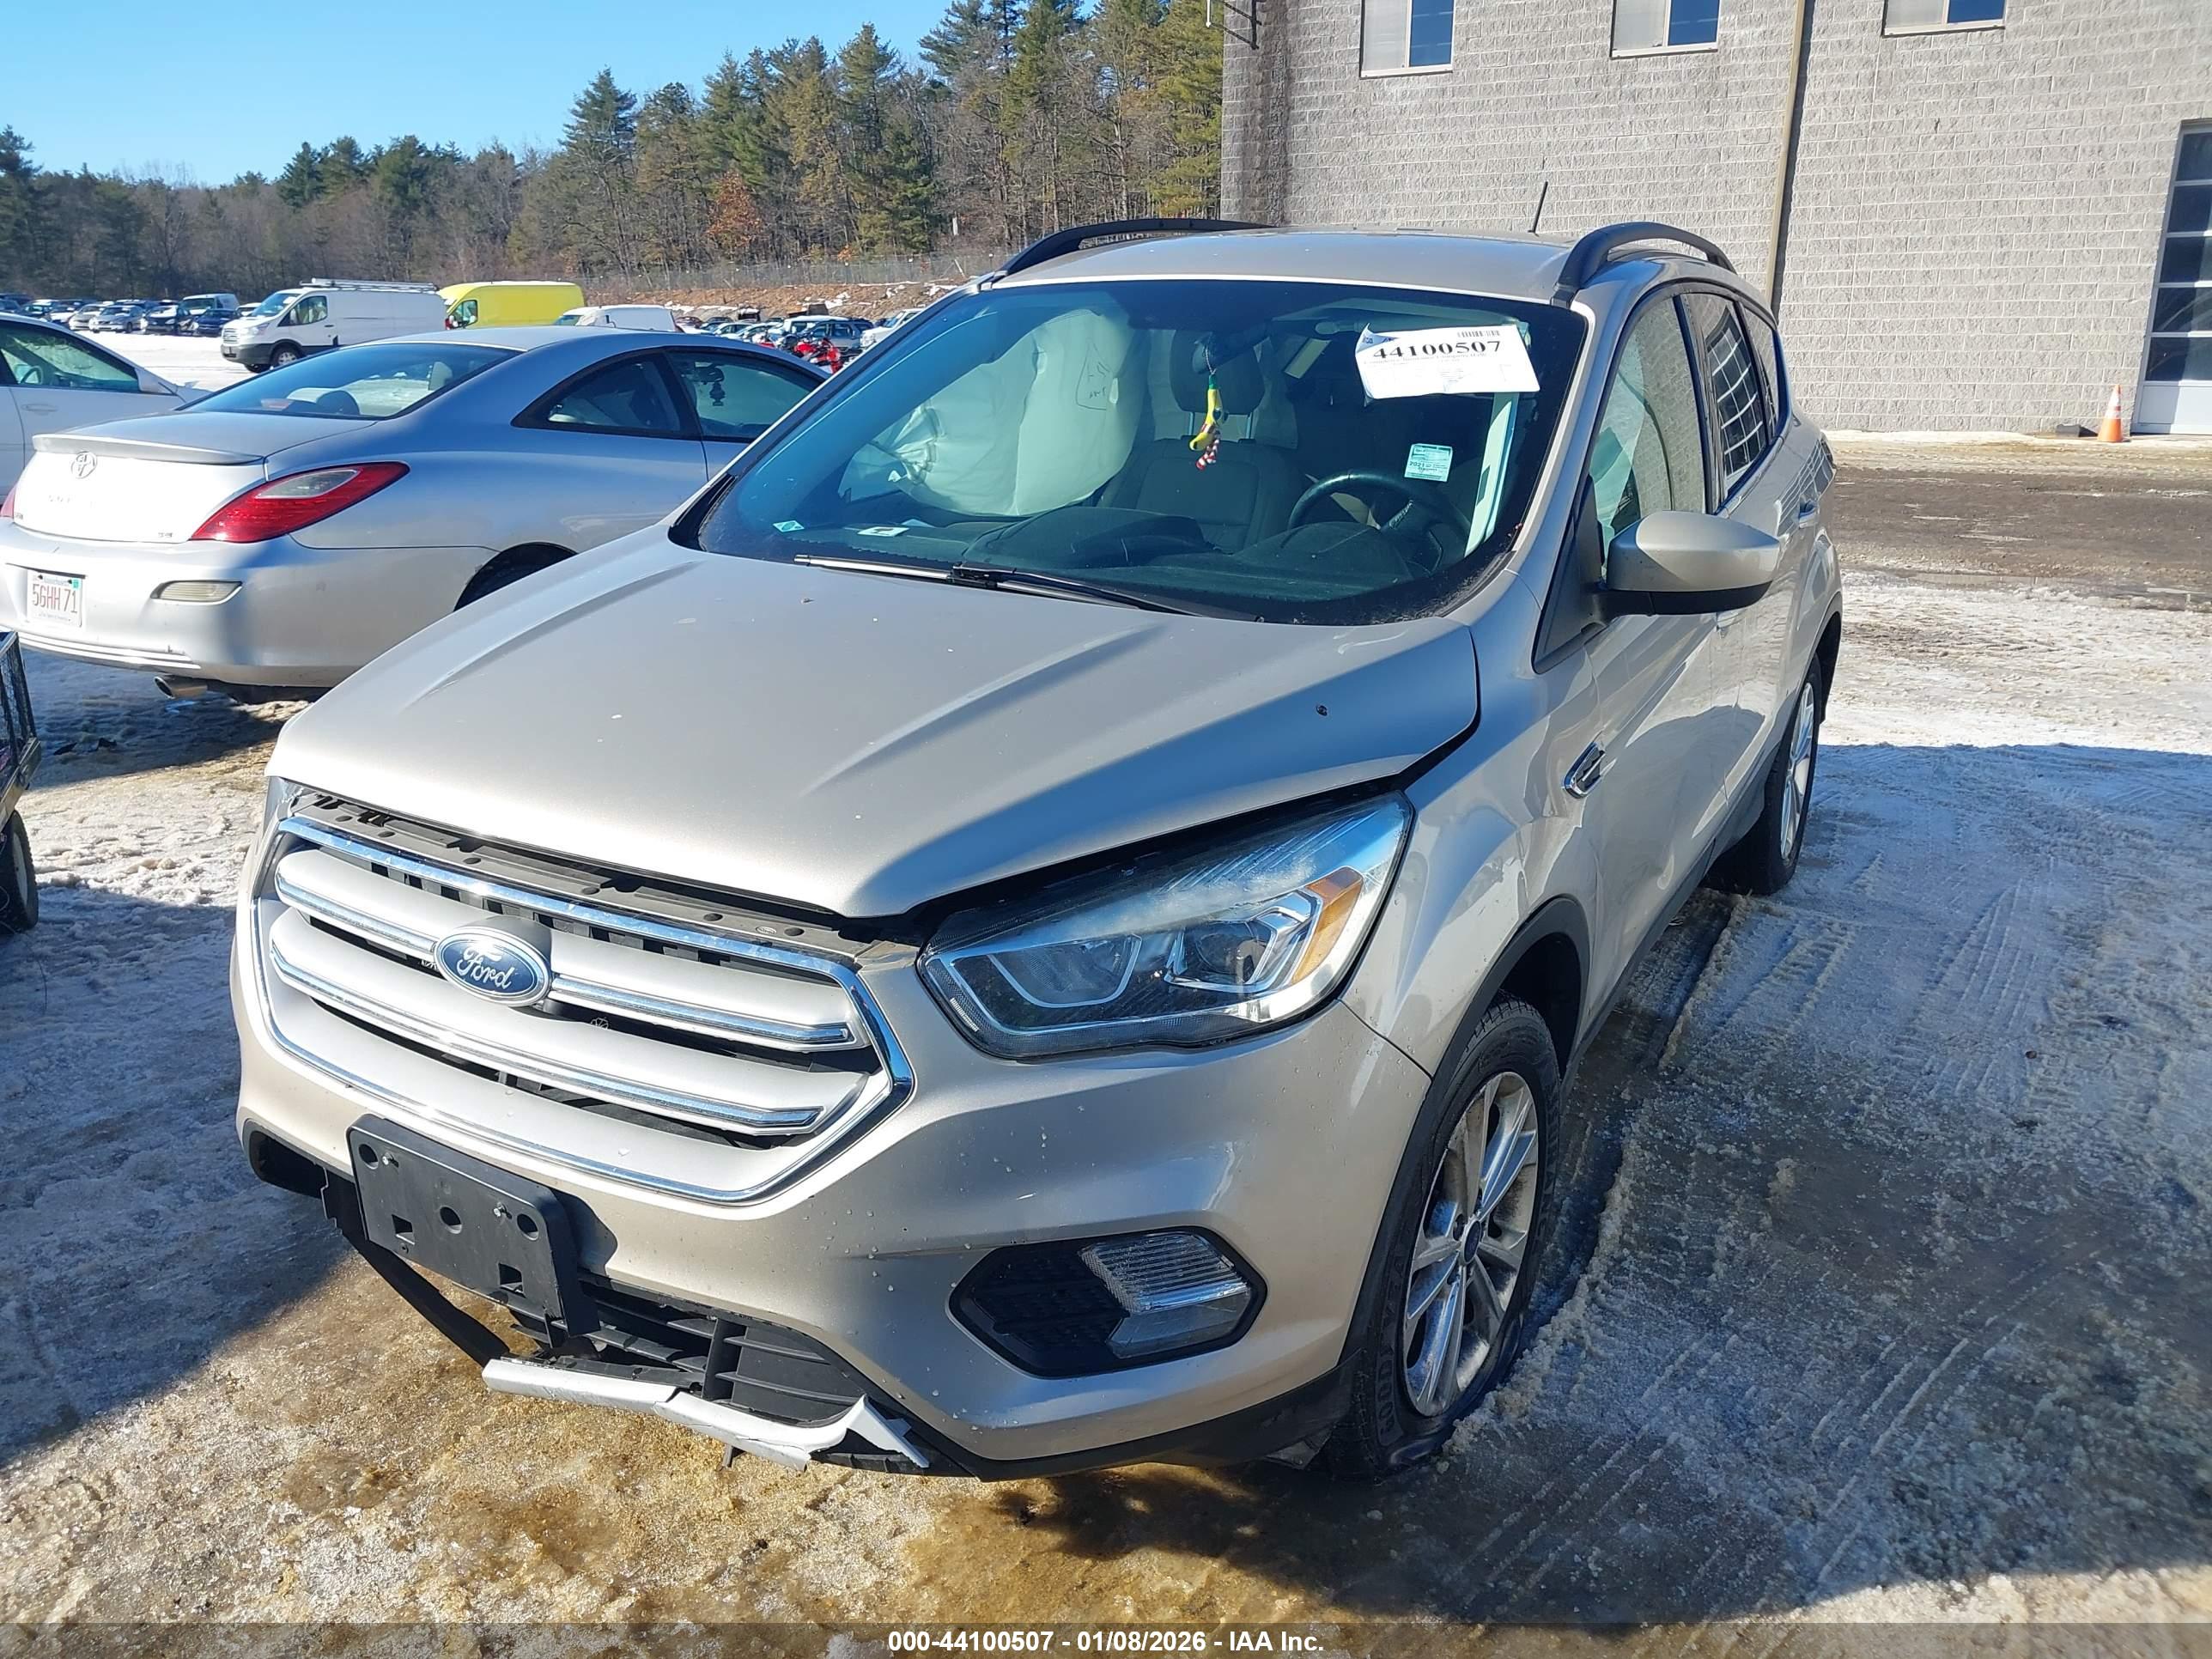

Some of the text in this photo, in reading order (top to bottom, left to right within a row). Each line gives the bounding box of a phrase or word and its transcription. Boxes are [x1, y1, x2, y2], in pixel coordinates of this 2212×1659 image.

[1373, 341, 1500, 358] 44100507
[64, 588, 77, 613] 71
[456, 945, 515, 989] Ford
